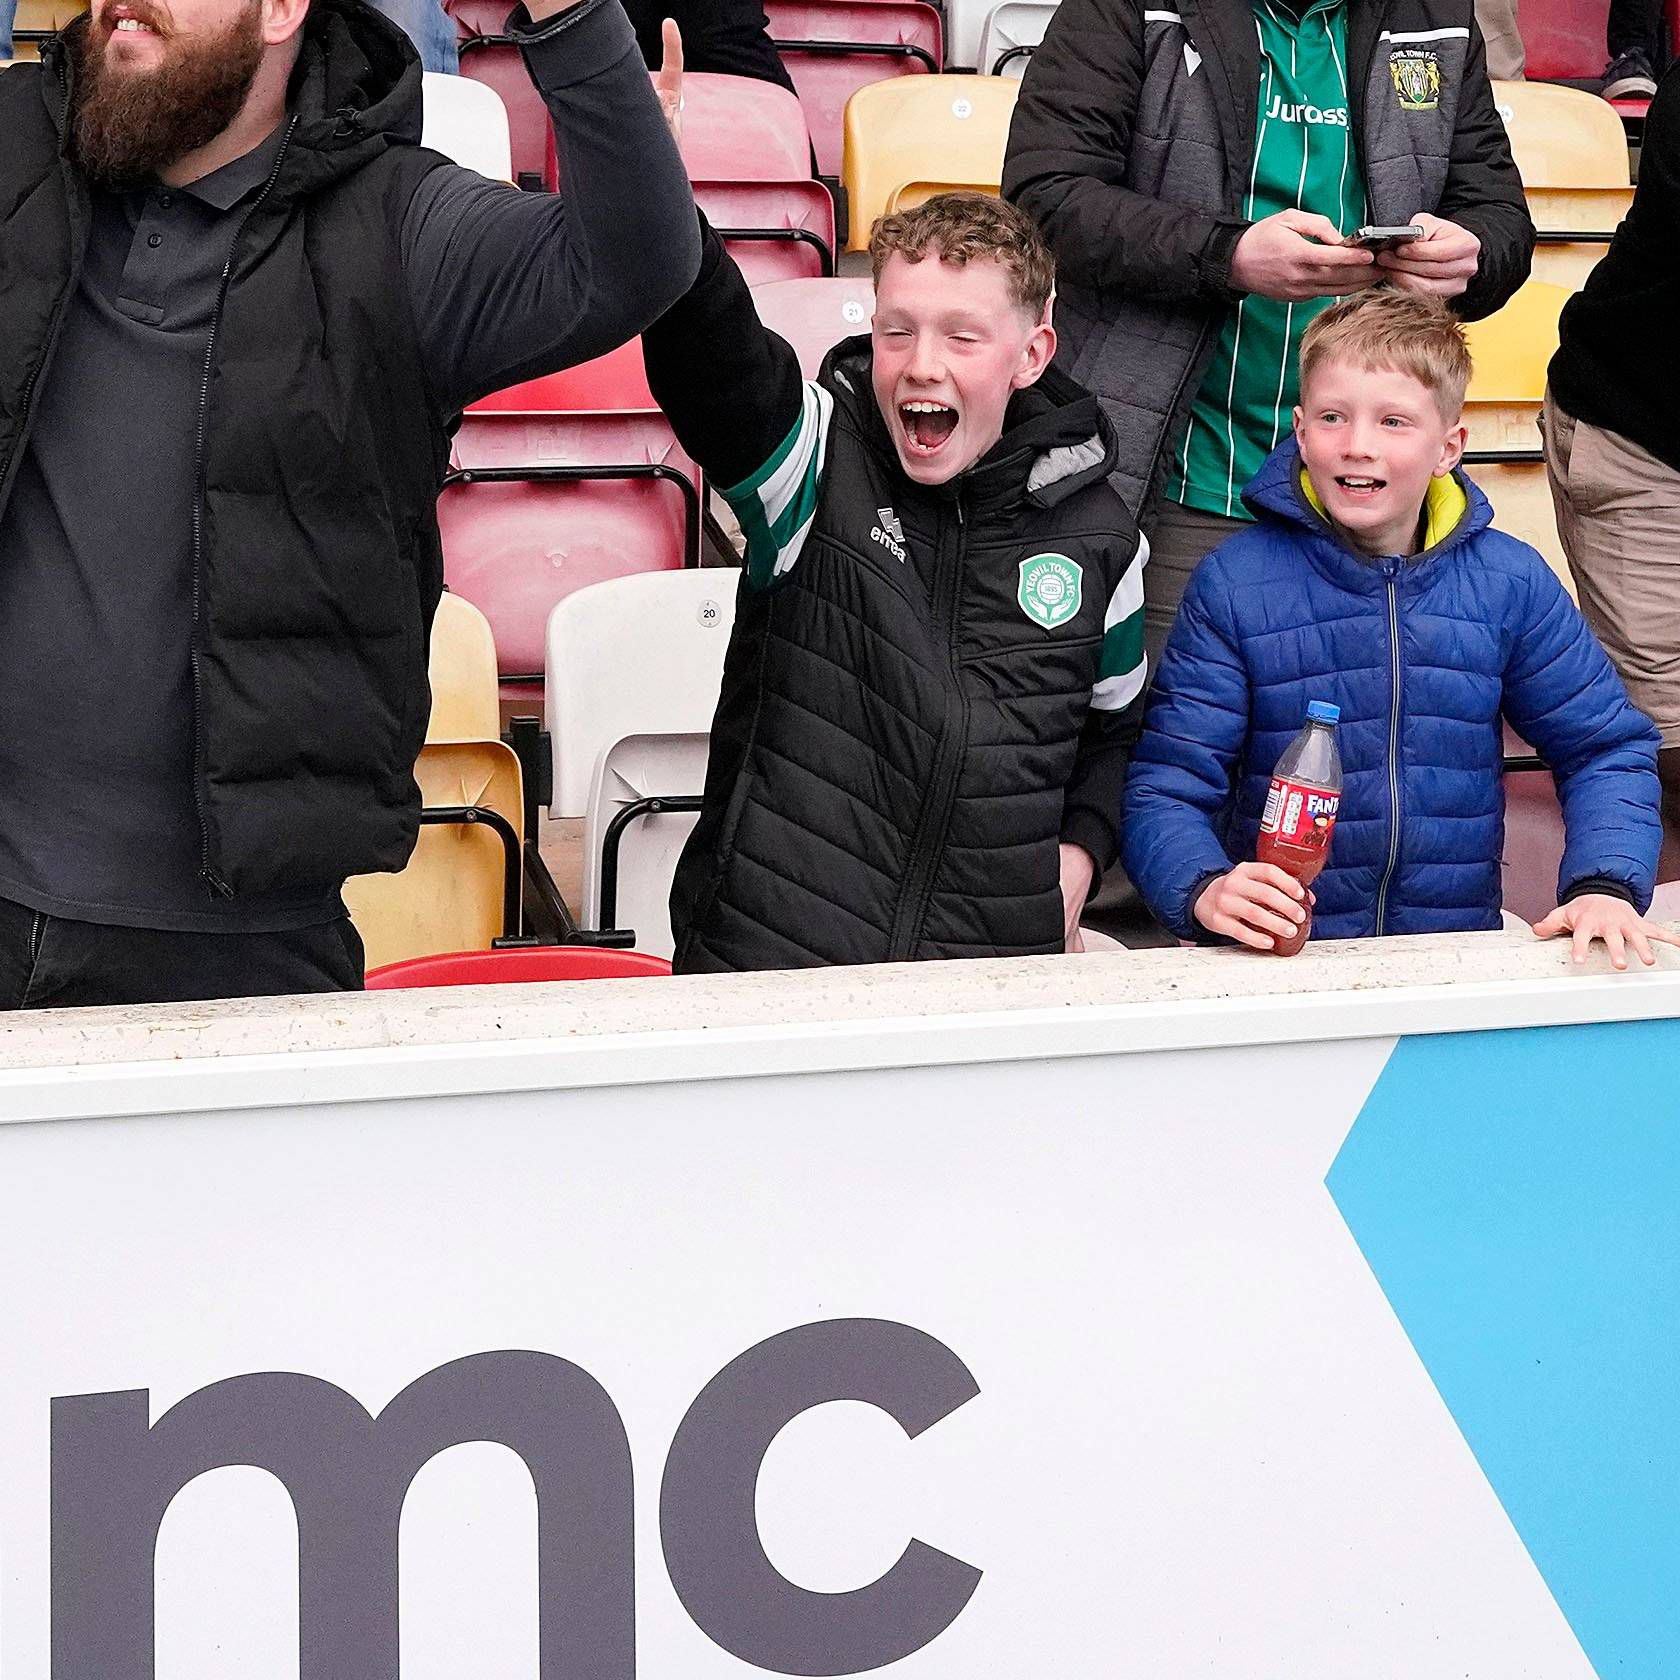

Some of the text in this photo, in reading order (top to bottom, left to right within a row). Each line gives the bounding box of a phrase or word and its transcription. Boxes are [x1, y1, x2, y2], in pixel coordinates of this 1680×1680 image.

[1026, 563, 1049, 594] YEOVIL
[1049, 562, 1074, 584] TOWN
[703, 609, 716, 619] 20
[1307, 794, 1340, 814] FANT
